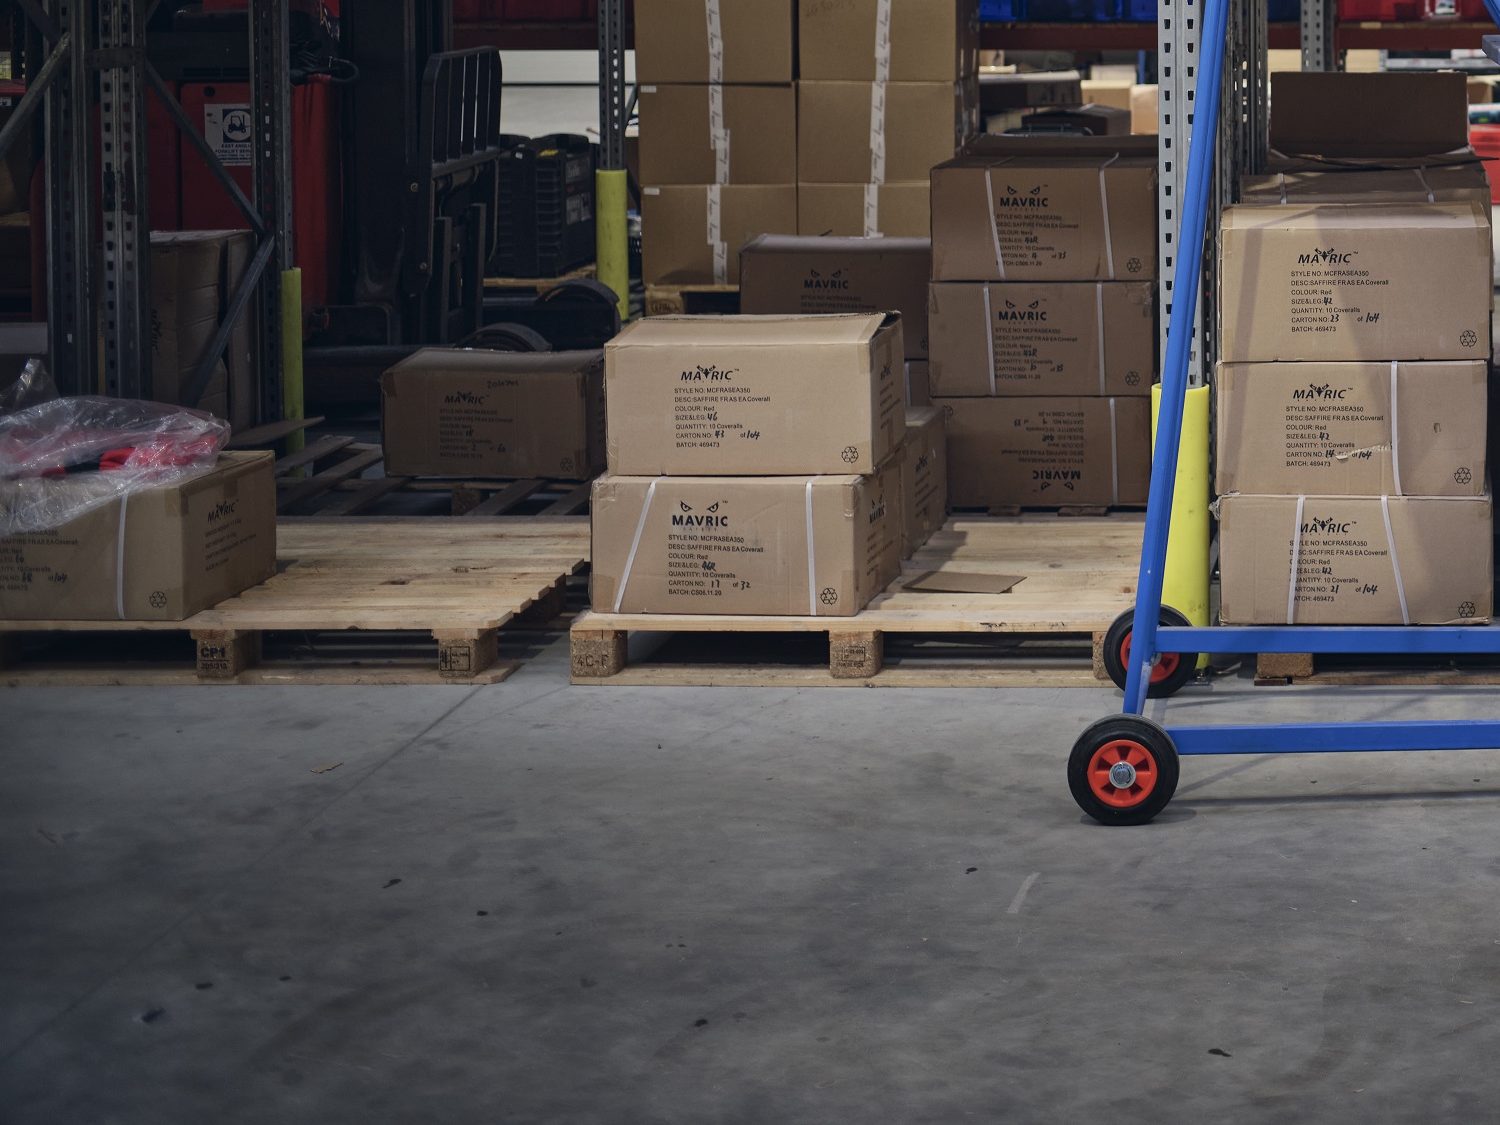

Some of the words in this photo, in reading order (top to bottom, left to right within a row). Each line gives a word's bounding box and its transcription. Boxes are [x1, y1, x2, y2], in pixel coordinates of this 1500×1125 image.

[1000, 198, 1048, 207] MAVRIC
[999, 312, 1046, 320] MAVRIC
[672, 516, 728, 526] MAVRIC
